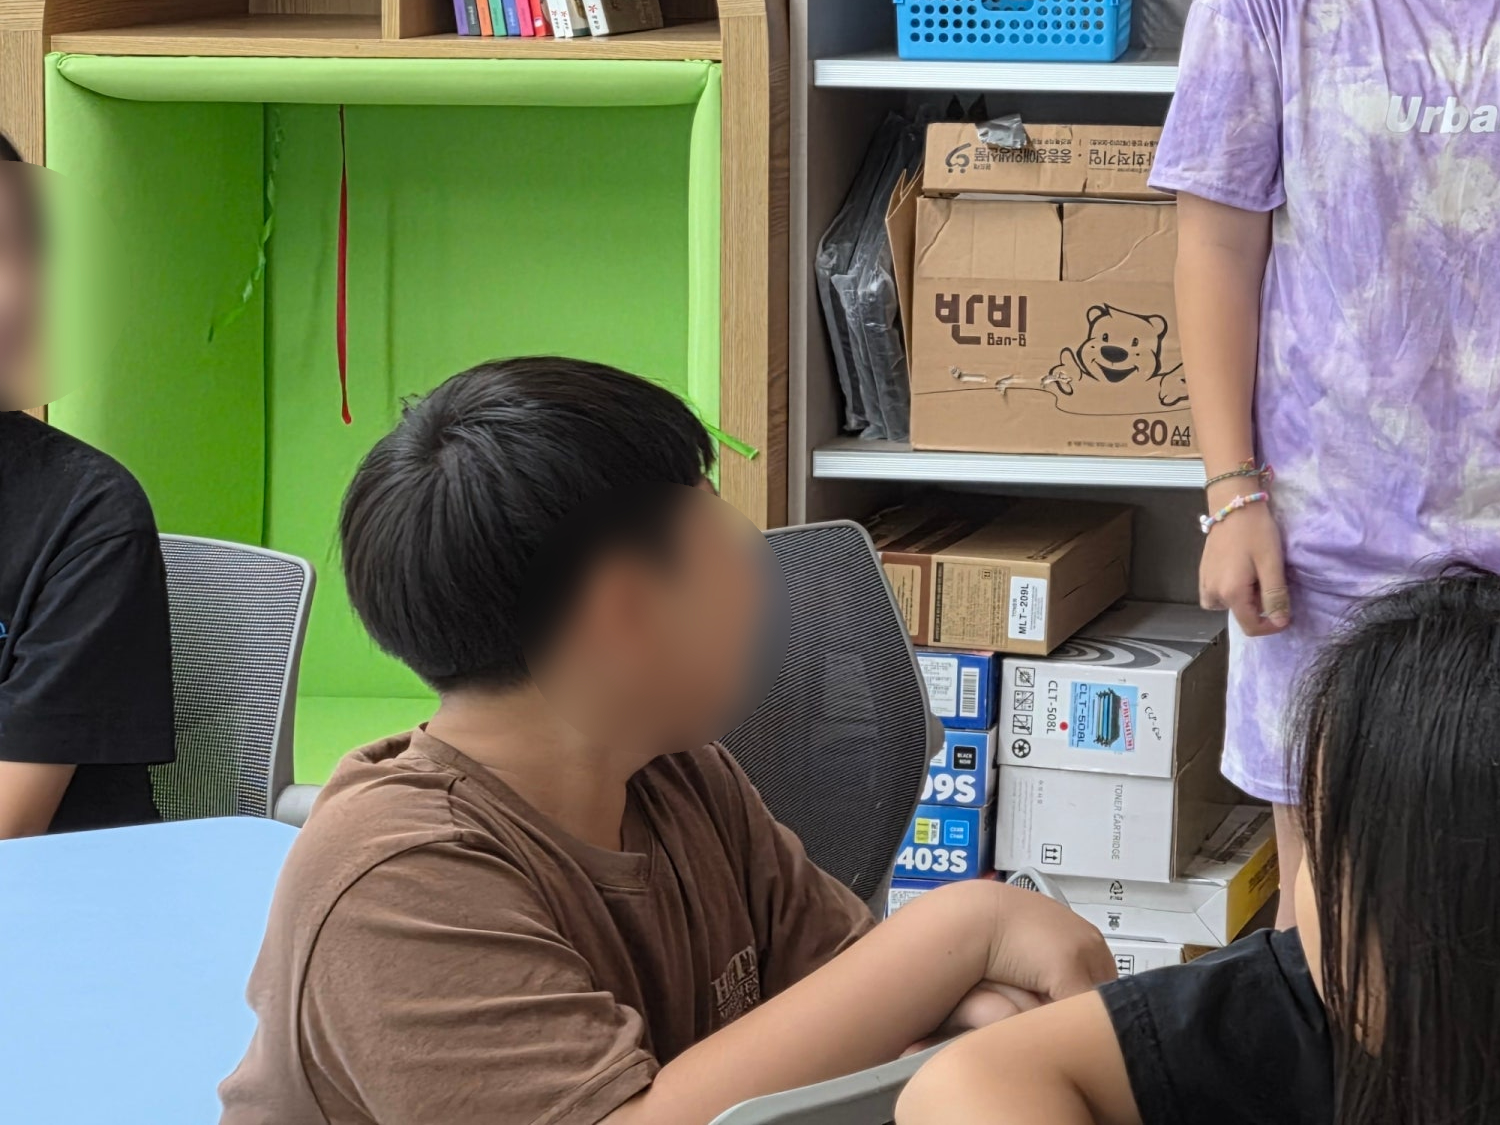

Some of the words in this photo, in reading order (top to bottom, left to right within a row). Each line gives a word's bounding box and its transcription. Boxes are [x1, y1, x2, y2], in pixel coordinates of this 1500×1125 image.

[935, 293, 1027, 345] 반비
[987, 332, 1027, 347] Ban-B
[1131, 418, 1168, 446] 80
[1018, 583, 1029, 635] MLT-209L
[1046, 679, 1058, 735] CLT-508L
[1076, 683, 1088, 748] CLT-508L
[1113, 784, 1123, 811] TONER
[897, 846, 968, 873] 403S
[1111, 813, 1123, 860] CARTRIDGE
